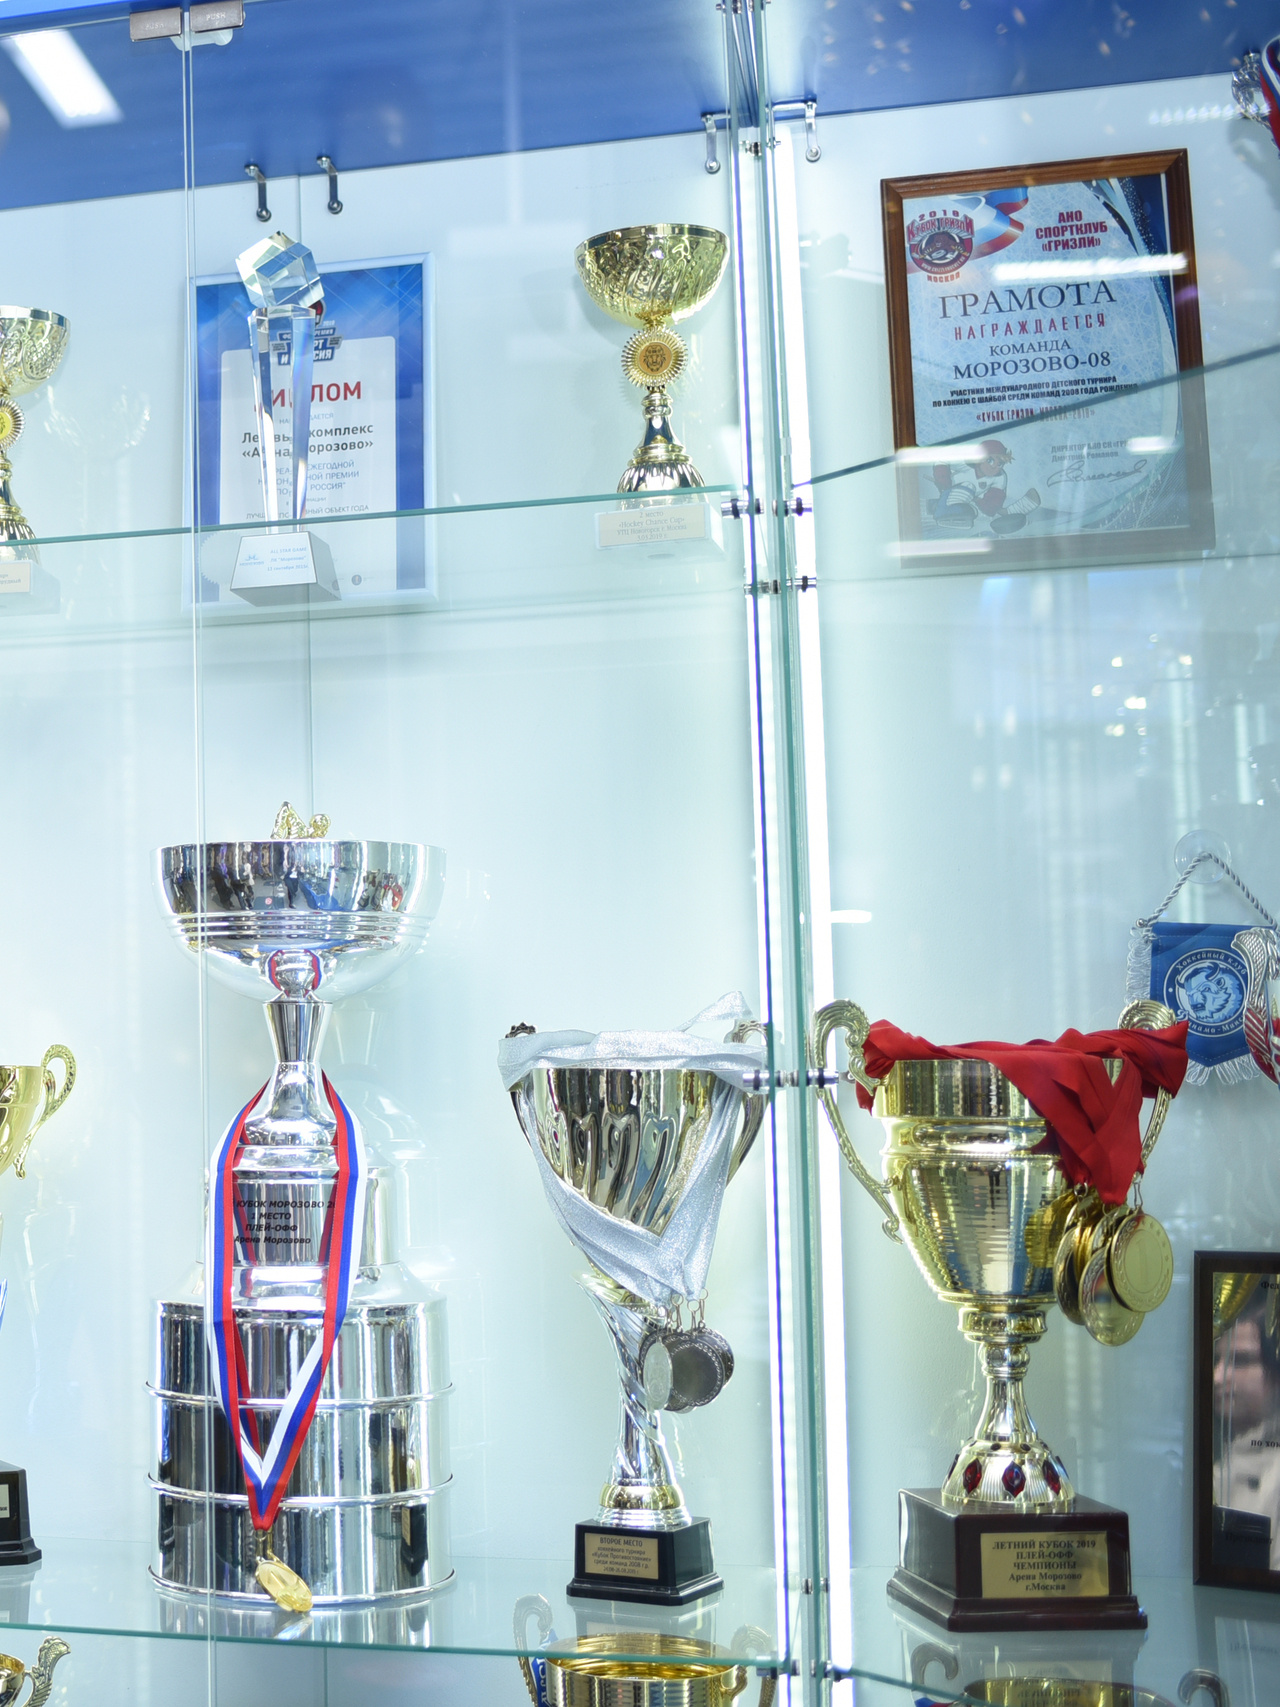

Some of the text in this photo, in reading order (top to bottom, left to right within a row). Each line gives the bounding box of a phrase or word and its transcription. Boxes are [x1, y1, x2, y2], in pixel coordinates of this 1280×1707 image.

[1058, 210, 1083, 224] АНО
[1035, 220, 1108, 241] СПОРТКЛУБ
[1041, 235, 1101, 253] «ГРИЗЛИ»
[938, 280, 1117, 319] ГРАМОТА
[954, 313, 1106, 341] НАГРАЖДАЕТСЯ
[989, 339, 1072, 357] КОМАНДА
[953, 352, 1111, 380] МОРОЗОВО-08
[950, 376, 1117, 397] УЧАСТНИК МЕЖДУНАРОДНОГО ДЕТСКОГО ТУРНИРА
[932, 400, 942, 408] ПО
[943, 398, 971, 407] ХОККЕЮ
[977, 394, 1007, 404] ШАЙБОЙ
[1007, 392, 1030, 401] СРЕДИ
[1031, 389, 1061, 399] КОМАНД
[1061, 387, 1080, 397] 2008
[1080, 386, 1099, 395] ГОДА
[309, 440, 374, 456] орозово»
[1175, 951, 1248, 976] Хоккейный клуб
[236, 1200, 267, 1209] КУБОК
[268, 1200, 325, 1209] МОРОЗОВО
[259, 1212, 292, 1220] МЕСТО
[245, 1222, 298, 1232] ПЛЕЙ-ОФФ
[234, 1235, 312, 1245] Арена Морозово
[599, 1536, 643, 1547] ВТОРОЕ МЕСТО
[992, 1539, 1096, 1550] ЛЕТНИЙ КУБОК 2019
[1016, 1550, 1073, 1560] ПЛЕЙ-ОФФ
[1013, 1561, 1077, 1570] ЧЕМПИОНЫ
[1008, 1572, 1082, 1583] Арена Морозово
